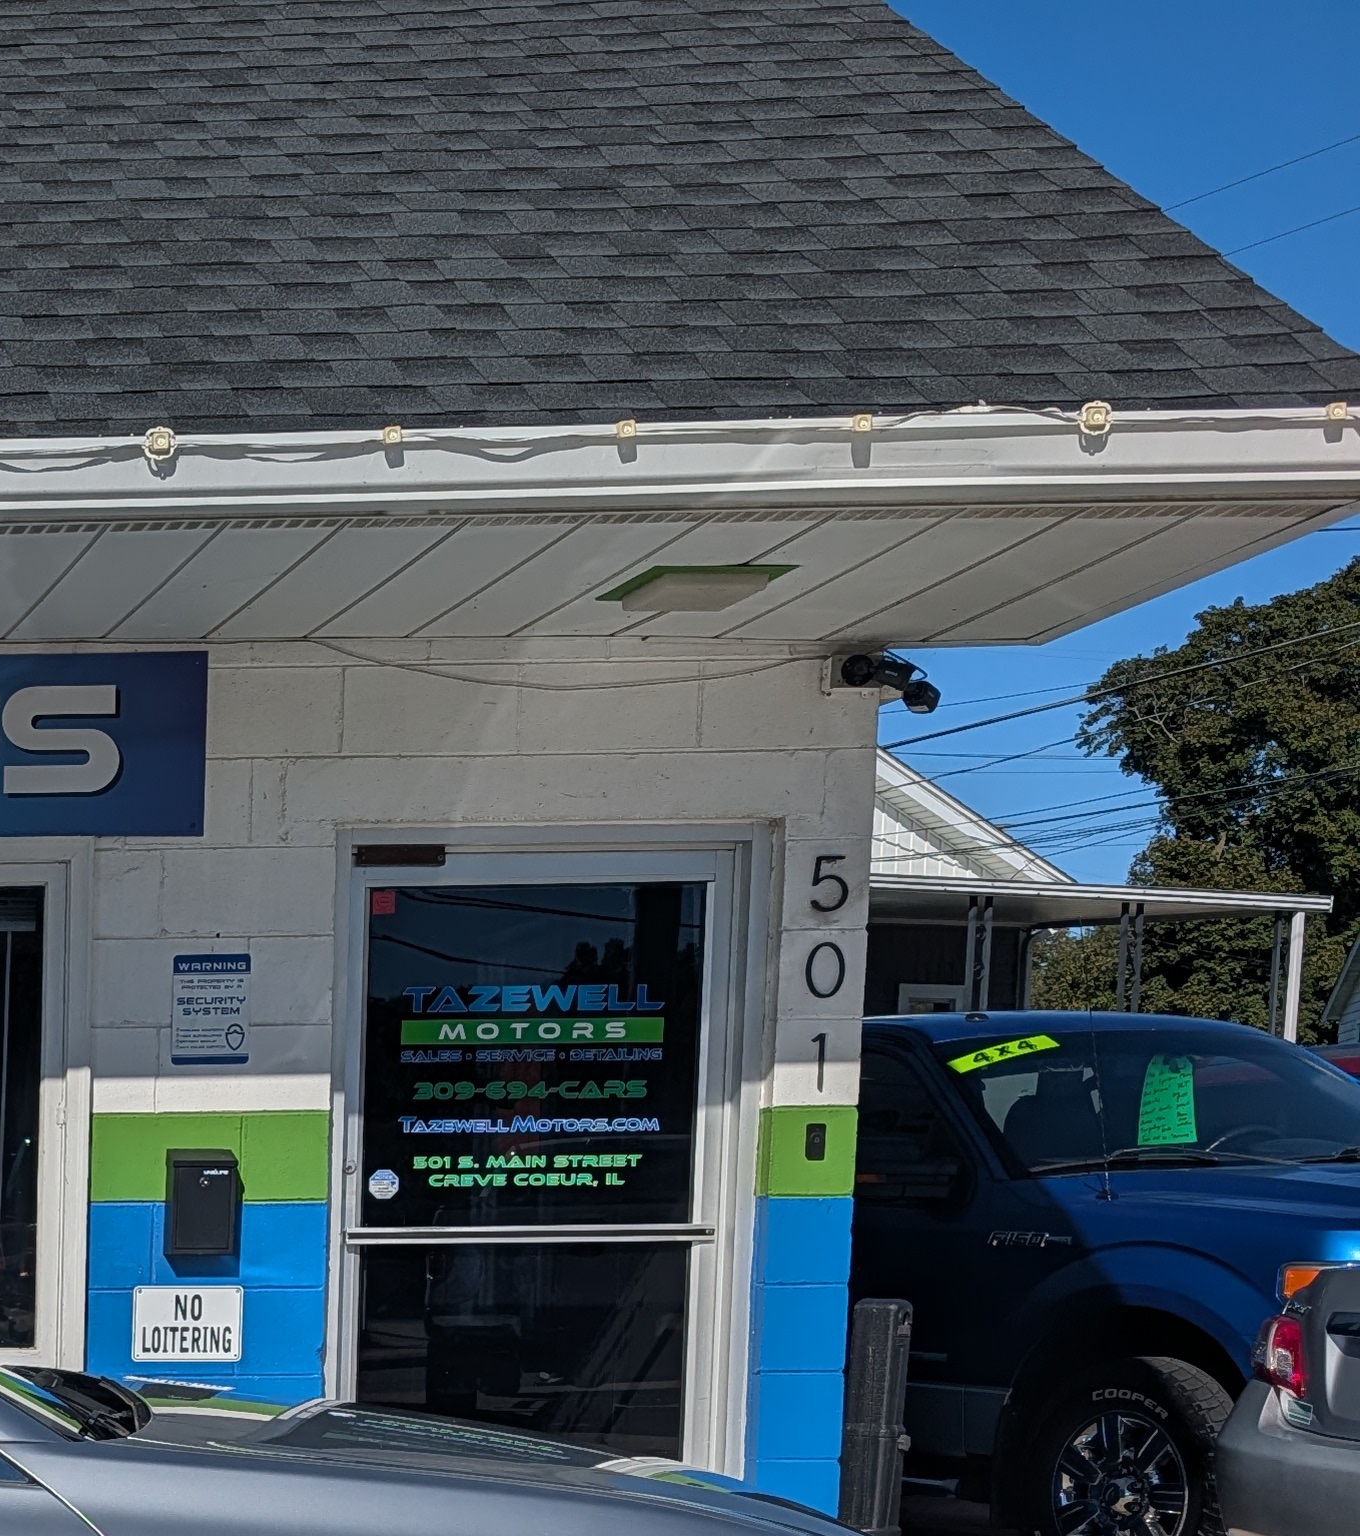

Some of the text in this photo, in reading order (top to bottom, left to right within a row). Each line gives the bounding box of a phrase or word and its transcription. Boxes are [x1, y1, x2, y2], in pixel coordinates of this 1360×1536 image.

[178, 962, 247, 971] WARNING
[176, 996, 247, 1006] SECURITY
[402, 984, 666, 1013] TAZEWELL
[182, 1007, 241, 1016] SYSTEM
[438, 1021, 627, 1040] MOTORS
[400, 1048, 662, 1063] SALES SERVICE DETAILING
[413, 1080, 647, 1100] 309-694-CARS
[413, 1154, 643, 1169] 501 S. MAIN STREET
[428, 1173, 625, 1187] CREVE COEUR, IL
[174, 1294, 203, 1321] NO
[141, 1325, 233, 1354] LOITERING
[1091, 1388, 1169, 1420] COOPER
